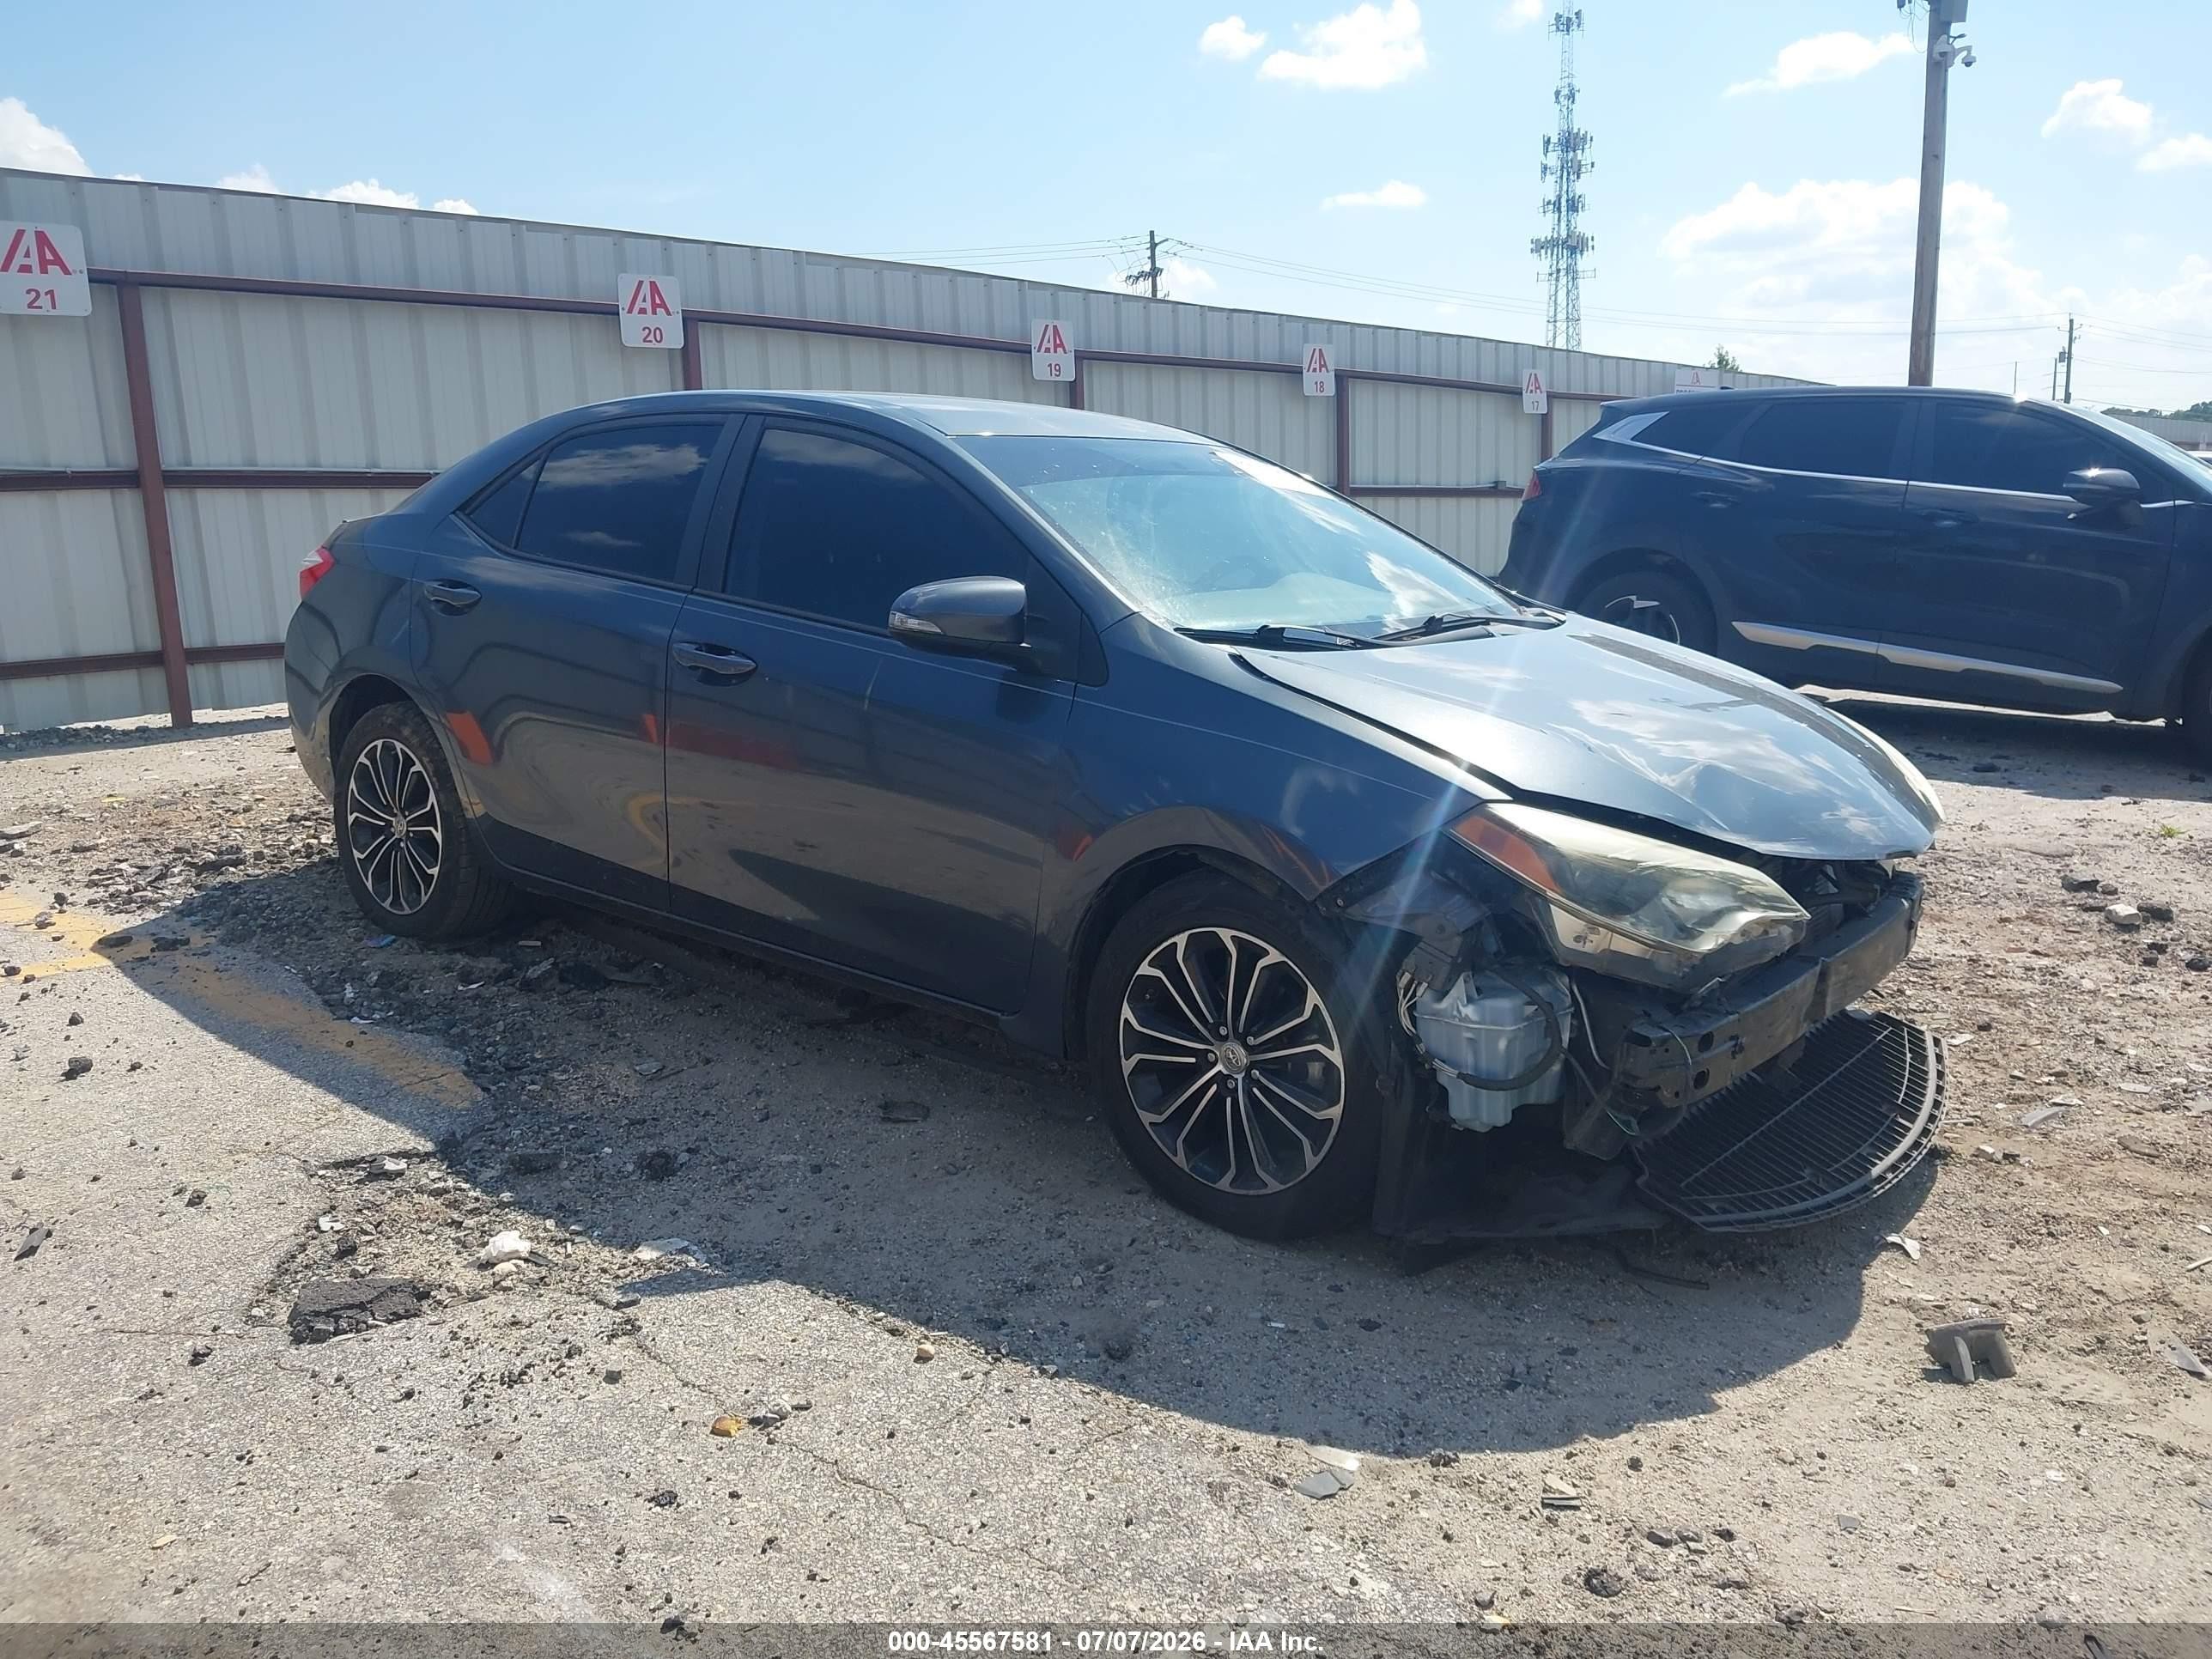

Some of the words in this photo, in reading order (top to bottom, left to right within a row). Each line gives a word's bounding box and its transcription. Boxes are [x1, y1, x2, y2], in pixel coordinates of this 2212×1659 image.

[25, 288, 57, 310] 21
[641, 326, 664, 343] 20
[1047, 362, 1061, 377] 19
[1314, 380, 1325, 393] 18
[1531, 400, 1540, 411] 17
